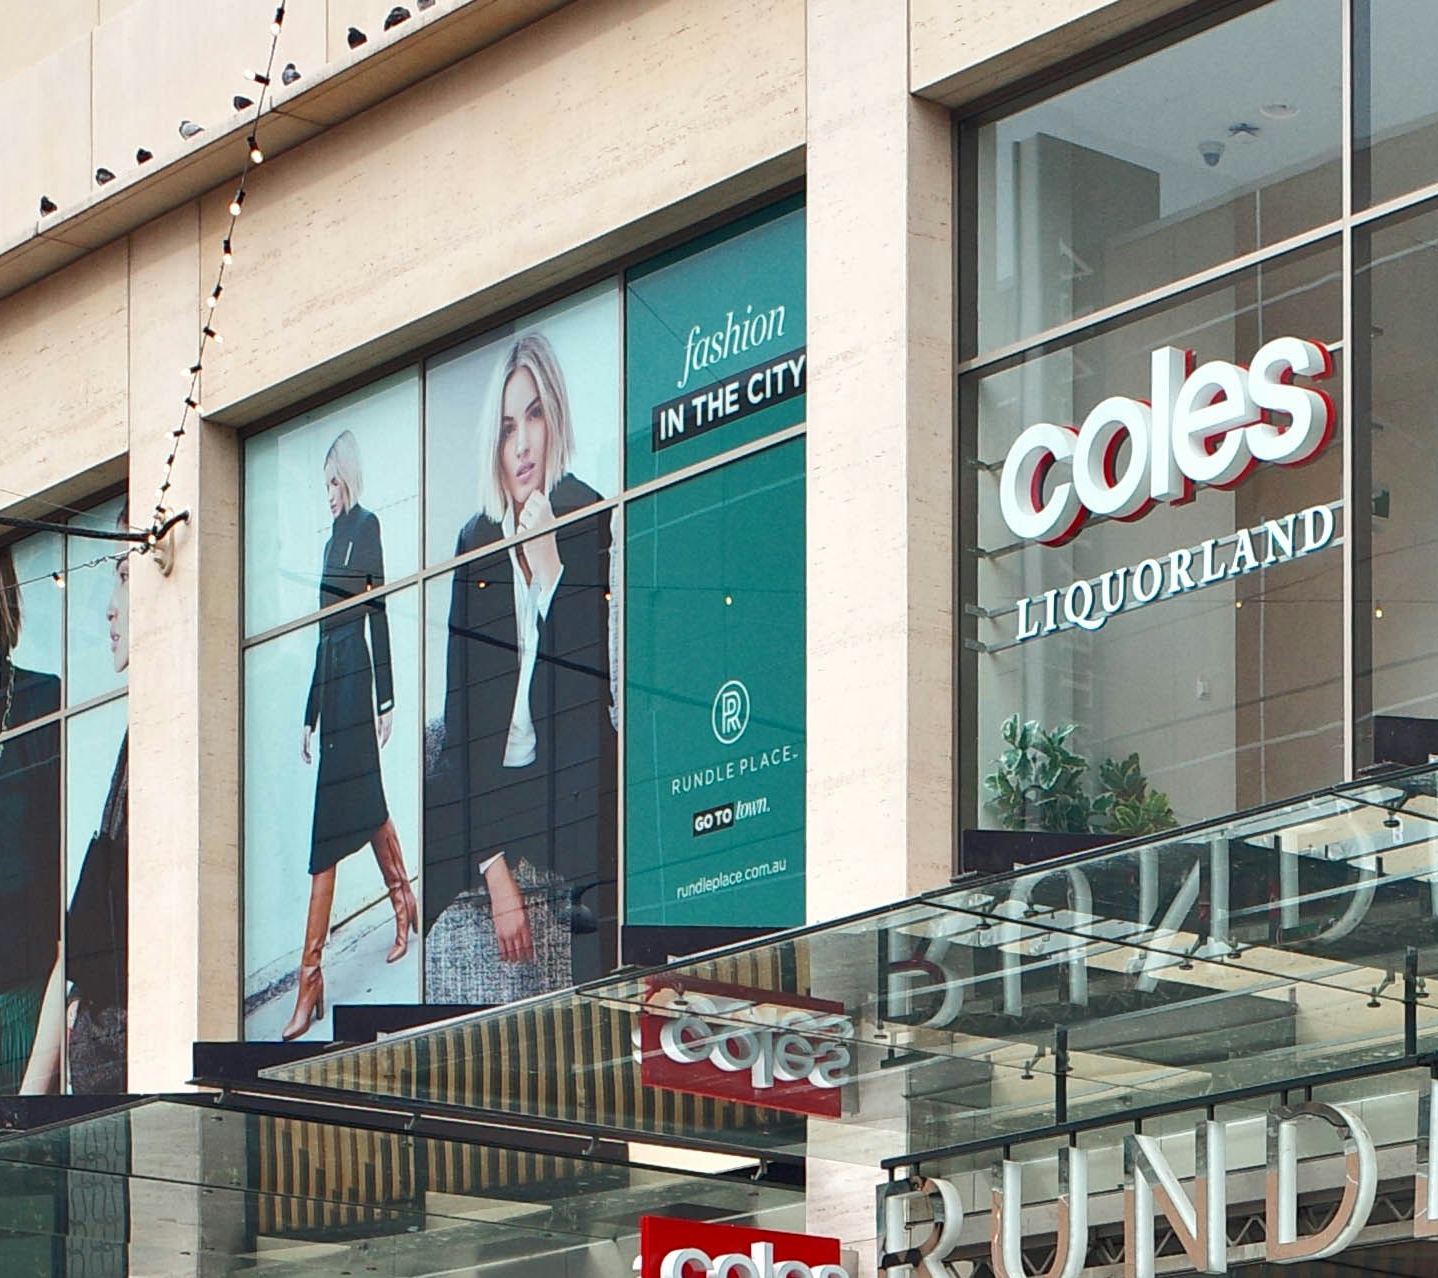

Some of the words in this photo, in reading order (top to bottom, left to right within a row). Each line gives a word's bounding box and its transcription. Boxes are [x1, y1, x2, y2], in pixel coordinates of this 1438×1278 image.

[677, 304, 786, 389] fashion
[659, 403, 685, 441] IN
[691, 381, 740, 427] THE
[747, 355, 806, 404] CITY
[998, 336, 1334, 546] coles
[1015, 503, 1337, 643] LIQUORLAND
[671, 762, 735, 796] RUNDLE
[694, 815, 712, 832] GO
[714, 808, 733, 826] TO
[676, 858, 787, 899] rundleplace.com.au
